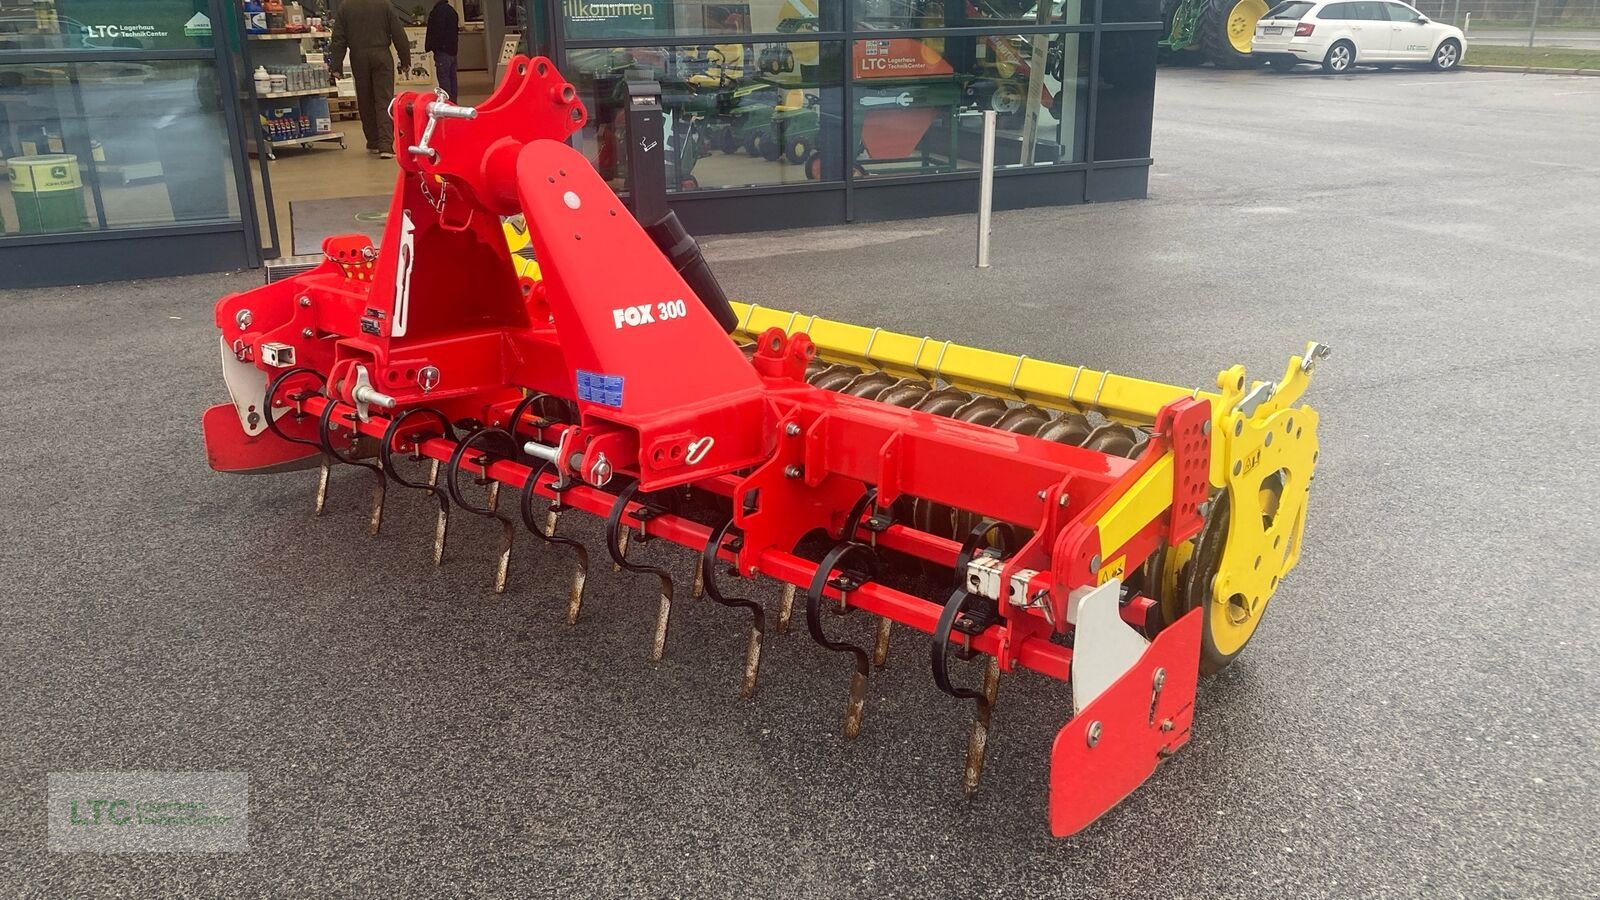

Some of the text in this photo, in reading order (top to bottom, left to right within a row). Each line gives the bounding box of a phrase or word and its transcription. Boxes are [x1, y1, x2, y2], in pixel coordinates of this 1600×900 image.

[563, 0, 653, 16] illkommen
[88, 25, 119, 38] LTC
[862, 58, 887, 70] LTC
[613, 299, 687, 329] FOX 300
